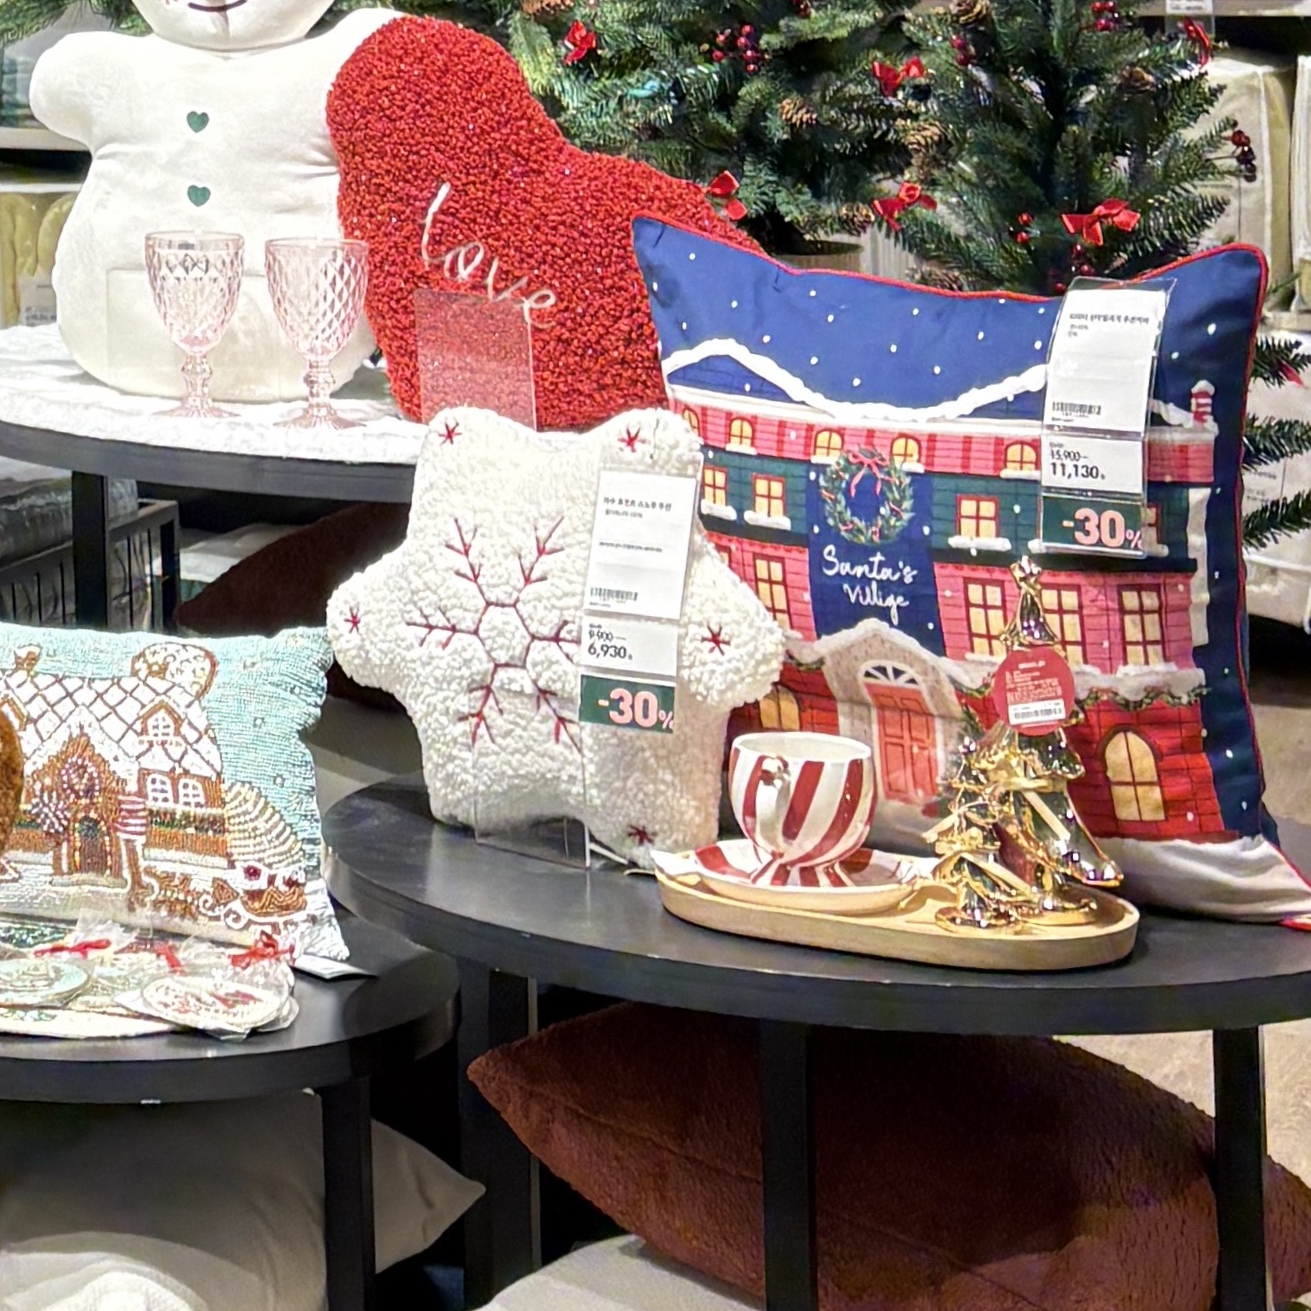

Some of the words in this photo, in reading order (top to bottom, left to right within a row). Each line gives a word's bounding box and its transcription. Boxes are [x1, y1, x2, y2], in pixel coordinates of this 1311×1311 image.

[421, 182, 557, 329] love
[1062, 507, 1143, 549] -30%
[822, 544, 918, 584] Santa's
[597, 687, 674, 729] -30%
